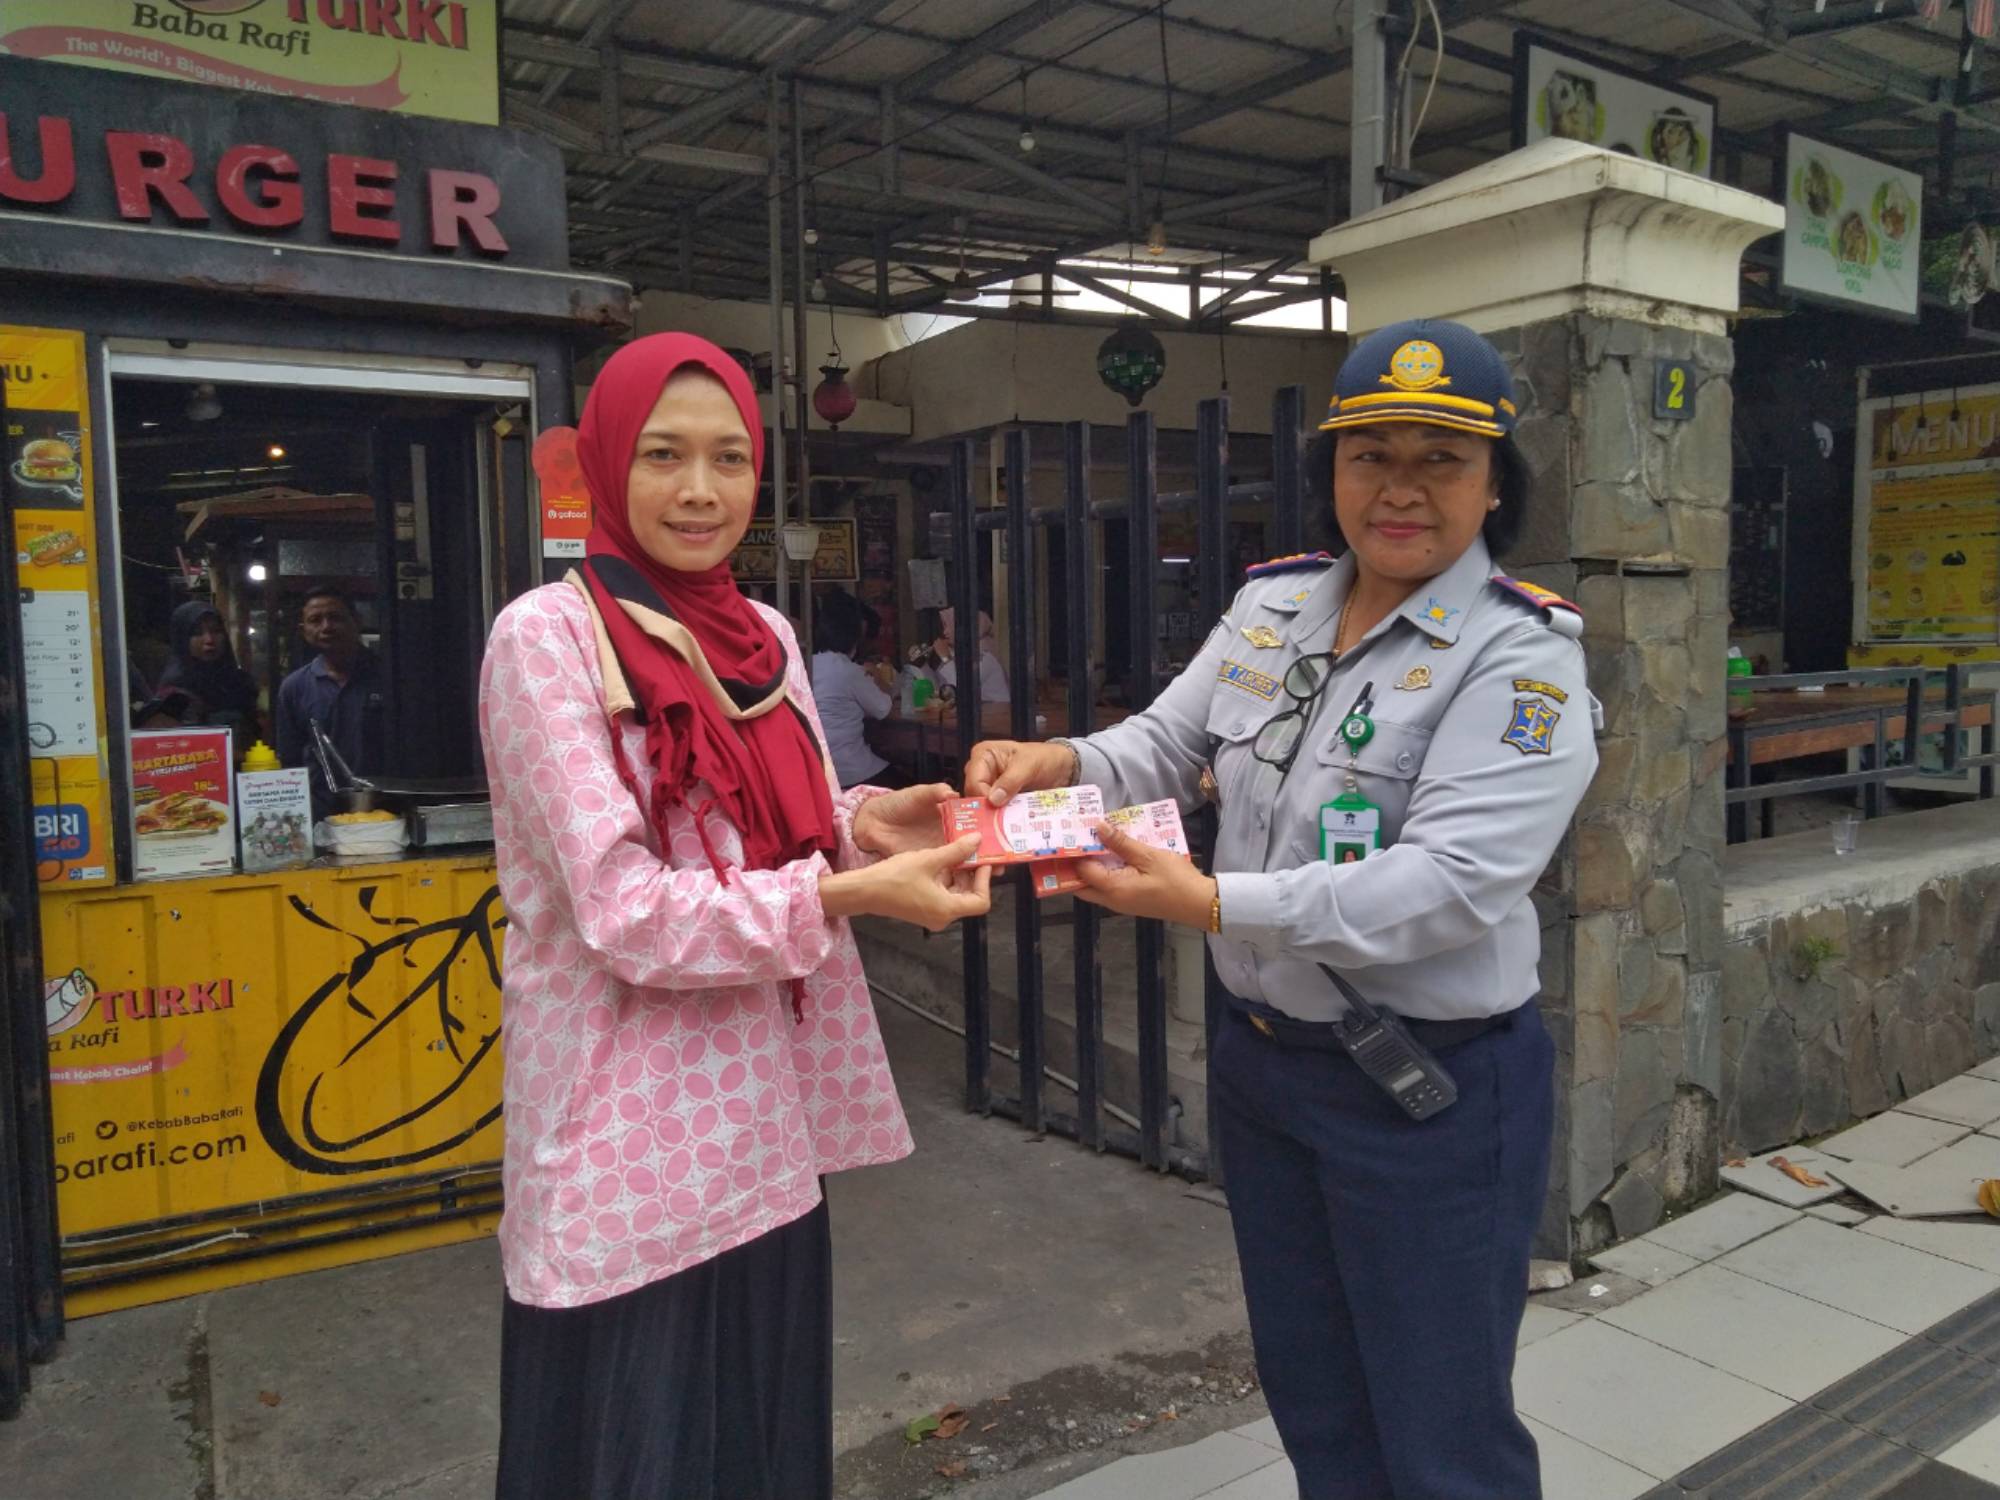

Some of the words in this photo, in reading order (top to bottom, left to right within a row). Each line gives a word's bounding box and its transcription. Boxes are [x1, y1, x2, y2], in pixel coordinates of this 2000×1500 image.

[132, 3, 229, 42] Baba
[240, 21, 310, 56] Rafi
[65, 36, 98, 53] The
[104, 39, 171, 67] World's
[176, 56, 241, 90] Biggest
[1666, 367, 1684, 408] 2
[1891, 412, 1997, 456] MENU
[34, 813, 79, 838] BRI
[95, 977, 234, 1024] TURKI
[71, 1027, 119, 1050] Rafi
[74, 1065, 111, 1080] Kebab
